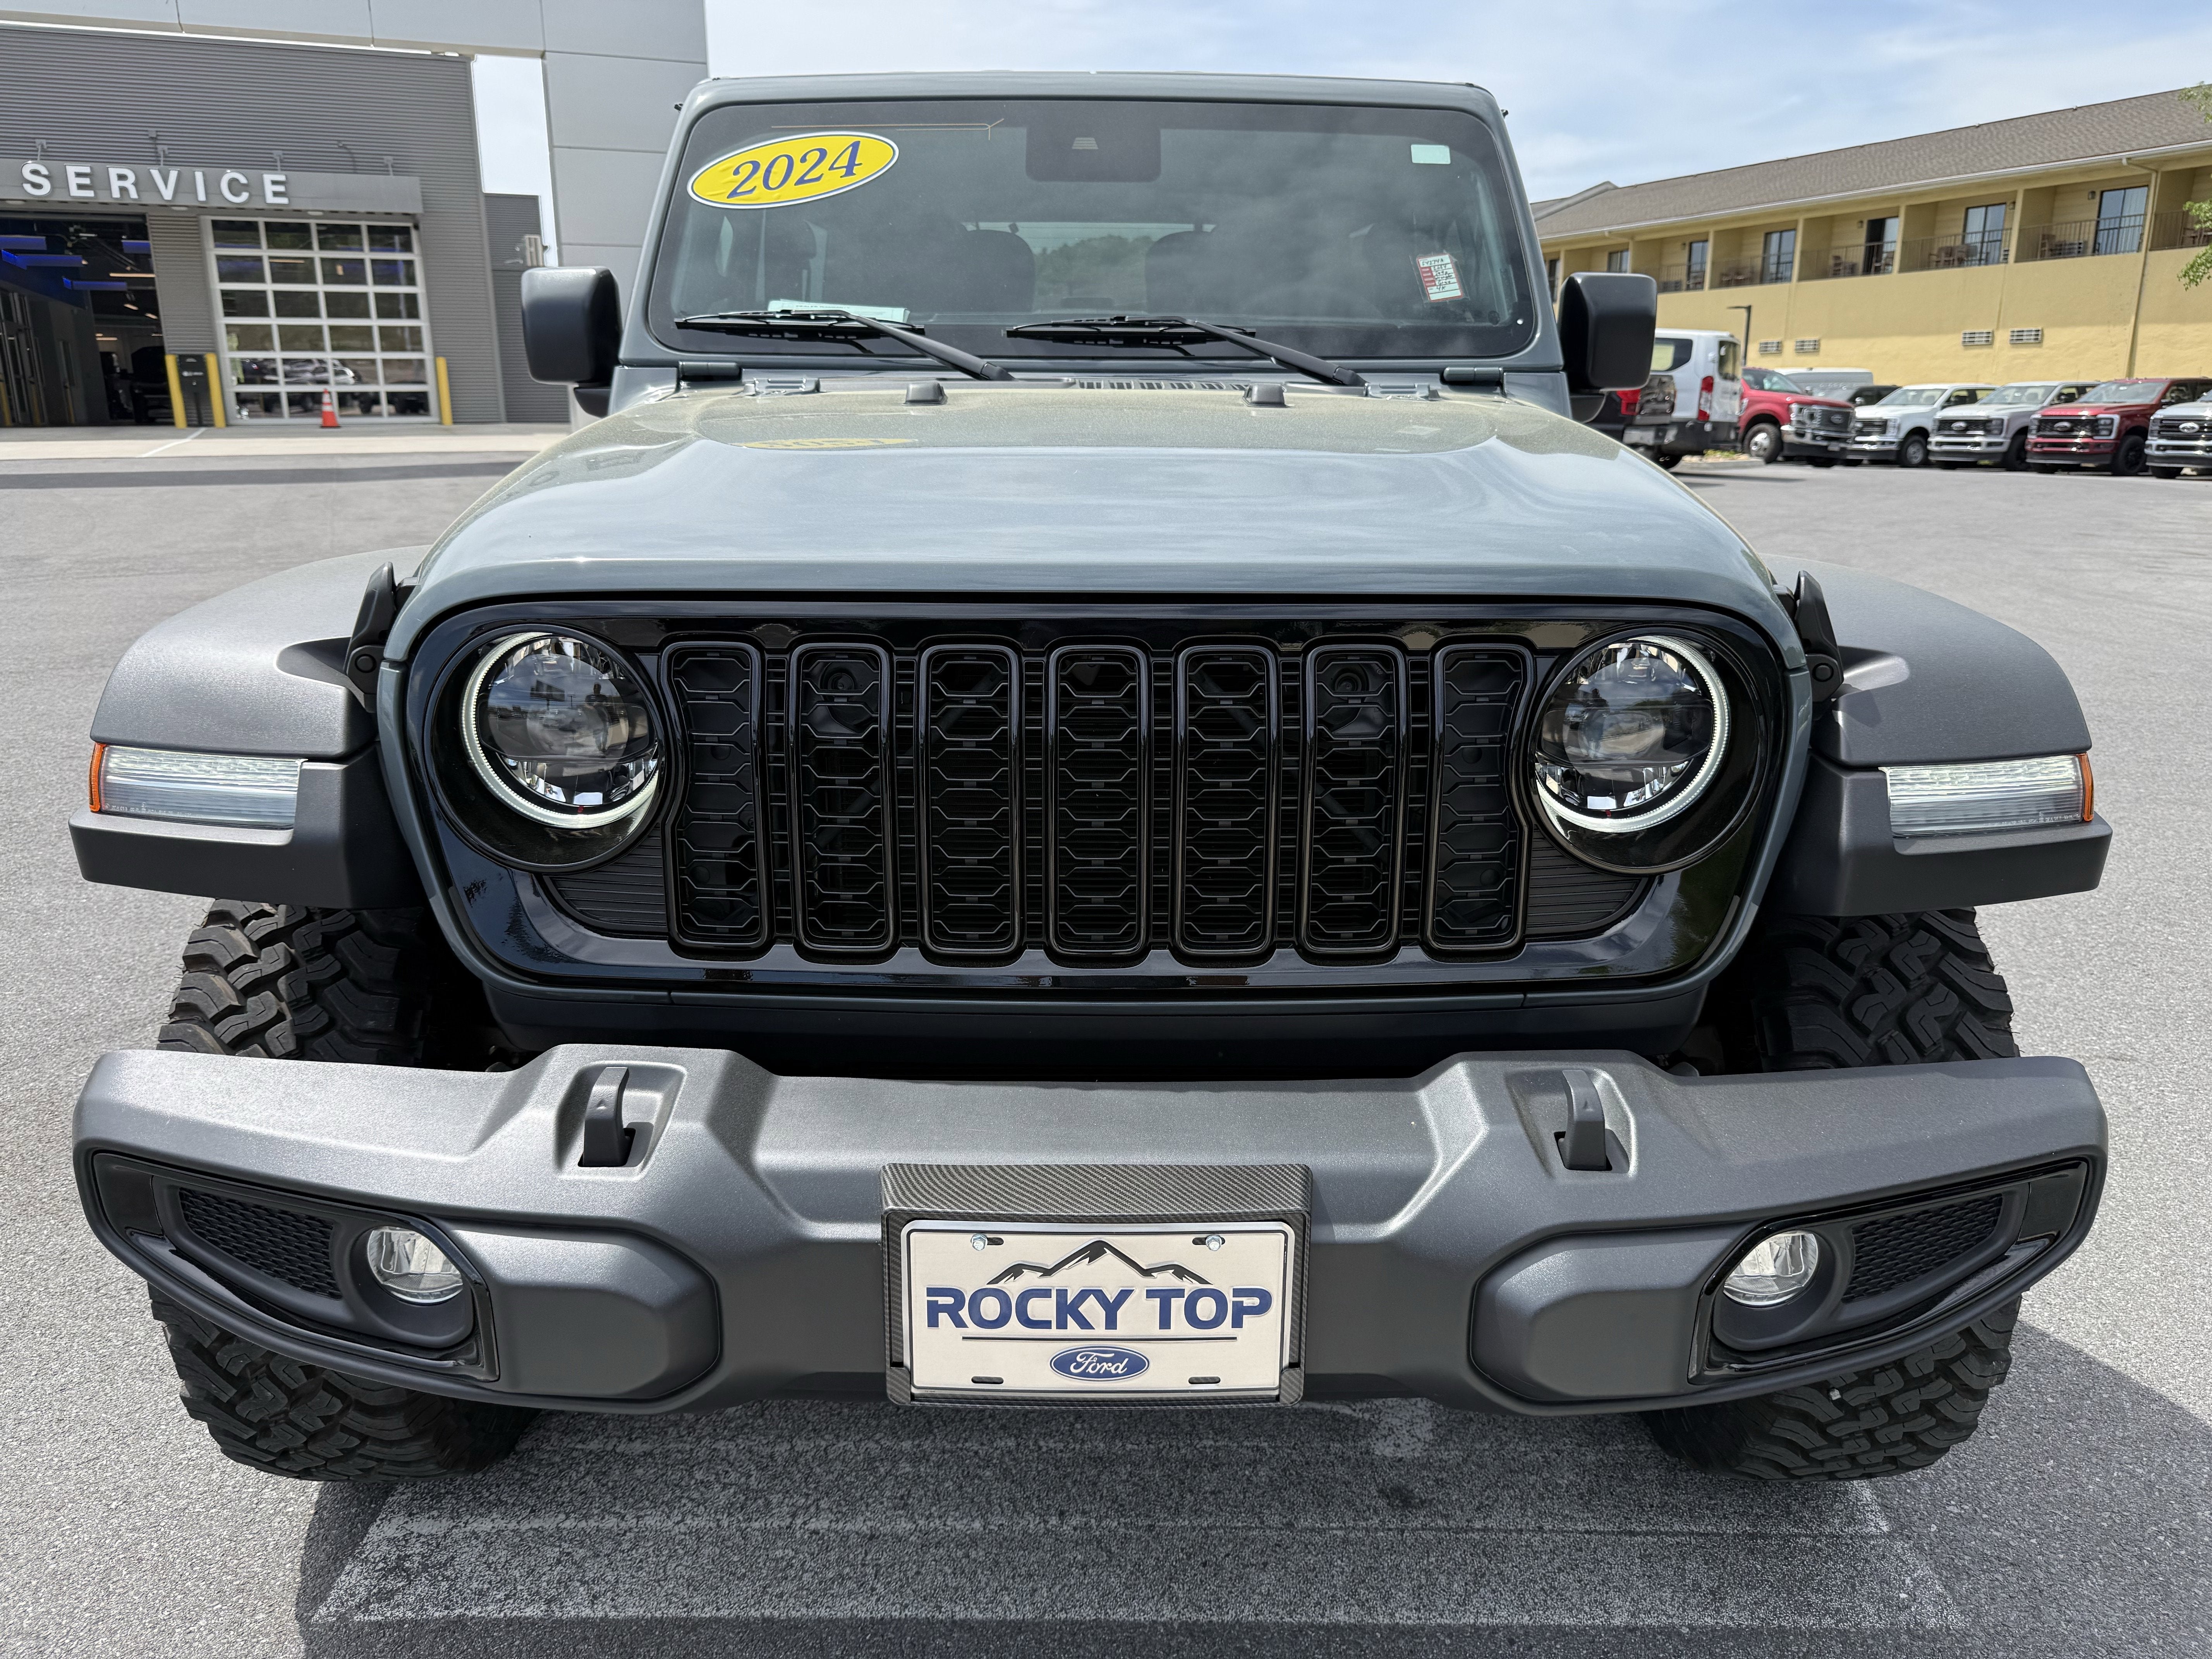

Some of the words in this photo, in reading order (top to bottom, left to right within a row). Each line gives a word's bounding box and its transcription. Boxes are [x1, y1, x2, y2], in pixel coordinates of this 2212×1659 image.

[21, 163, 289, 205] SERVICE
[727, 140, 862, 199] 2024
[926, 1287, 1135, 1330] ROCKY
[1146, 1288, 1272, 1330] TOP
[1069, 1352, 1129, 1374] Ford
